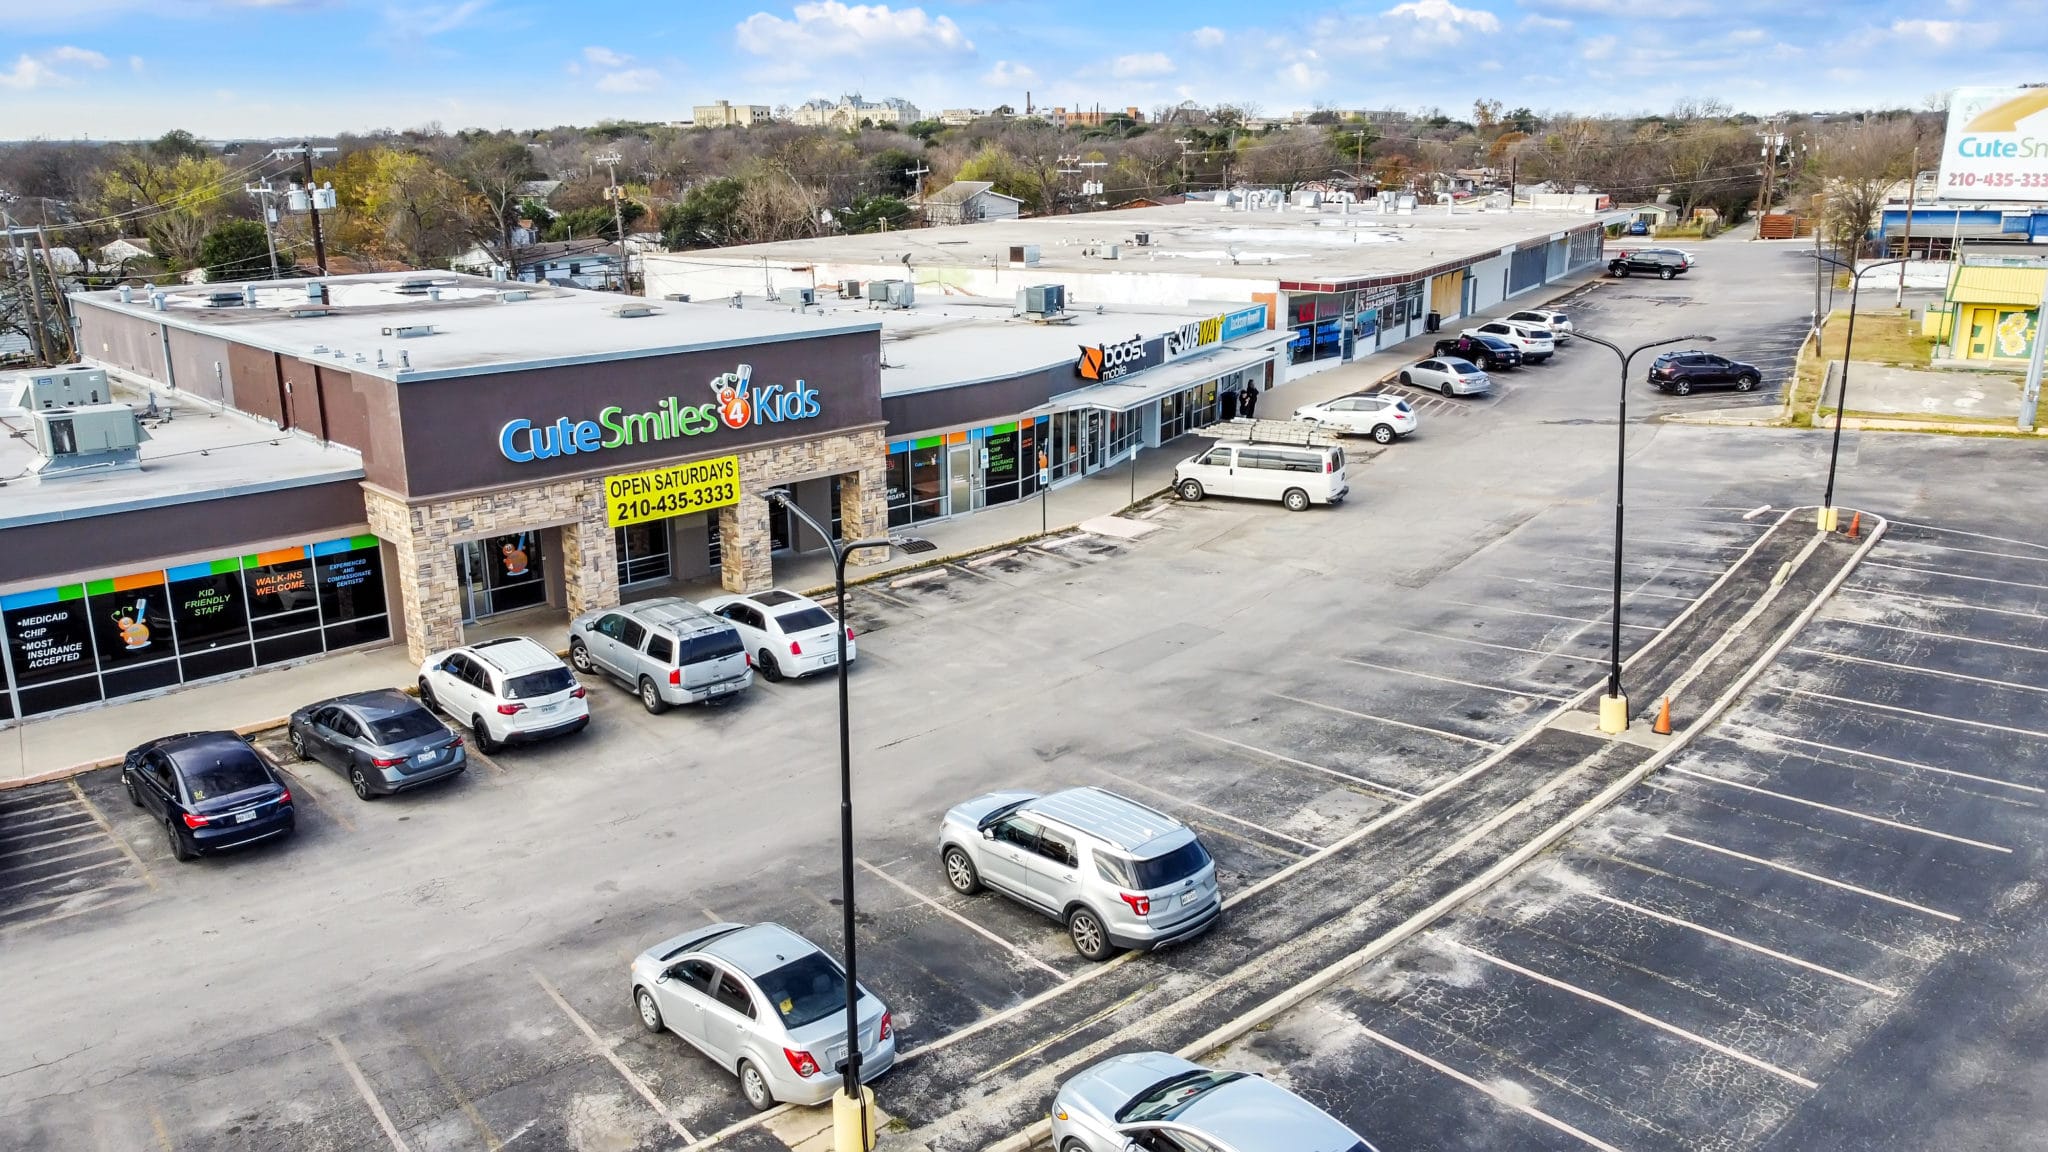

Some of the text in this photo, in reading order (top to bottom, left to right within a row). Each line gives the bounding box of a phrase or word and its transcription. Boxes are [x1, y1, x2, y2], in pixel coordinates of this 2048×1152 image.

[1169, 312, 1225, 354] SUBWAY
[1103, 335, 1146, 368] boost
[1102, 364, 1127, 381] mobile
[752, 379, 821, 426] Kids
[610, 461, 734, 499] OPEN SATURDAYS
[617, 483, 734, 520] 210-435-3333
[329, 559, 367, 571] EXPERIENCED
[256, 571, 303, 587] WALK-INS
[327, 570, 371, 583] COMPASSIONATE
[198, 588, 216, 599] KID
[256, 580, 305, 596] WELCOME
[185, 594, 231, 610] FRIENDLY
[194, 604, 224, 617] STAFF
[27, 642, 83, 660] INSURANCE
[28, 652, 80, 669] ACCEPTED
